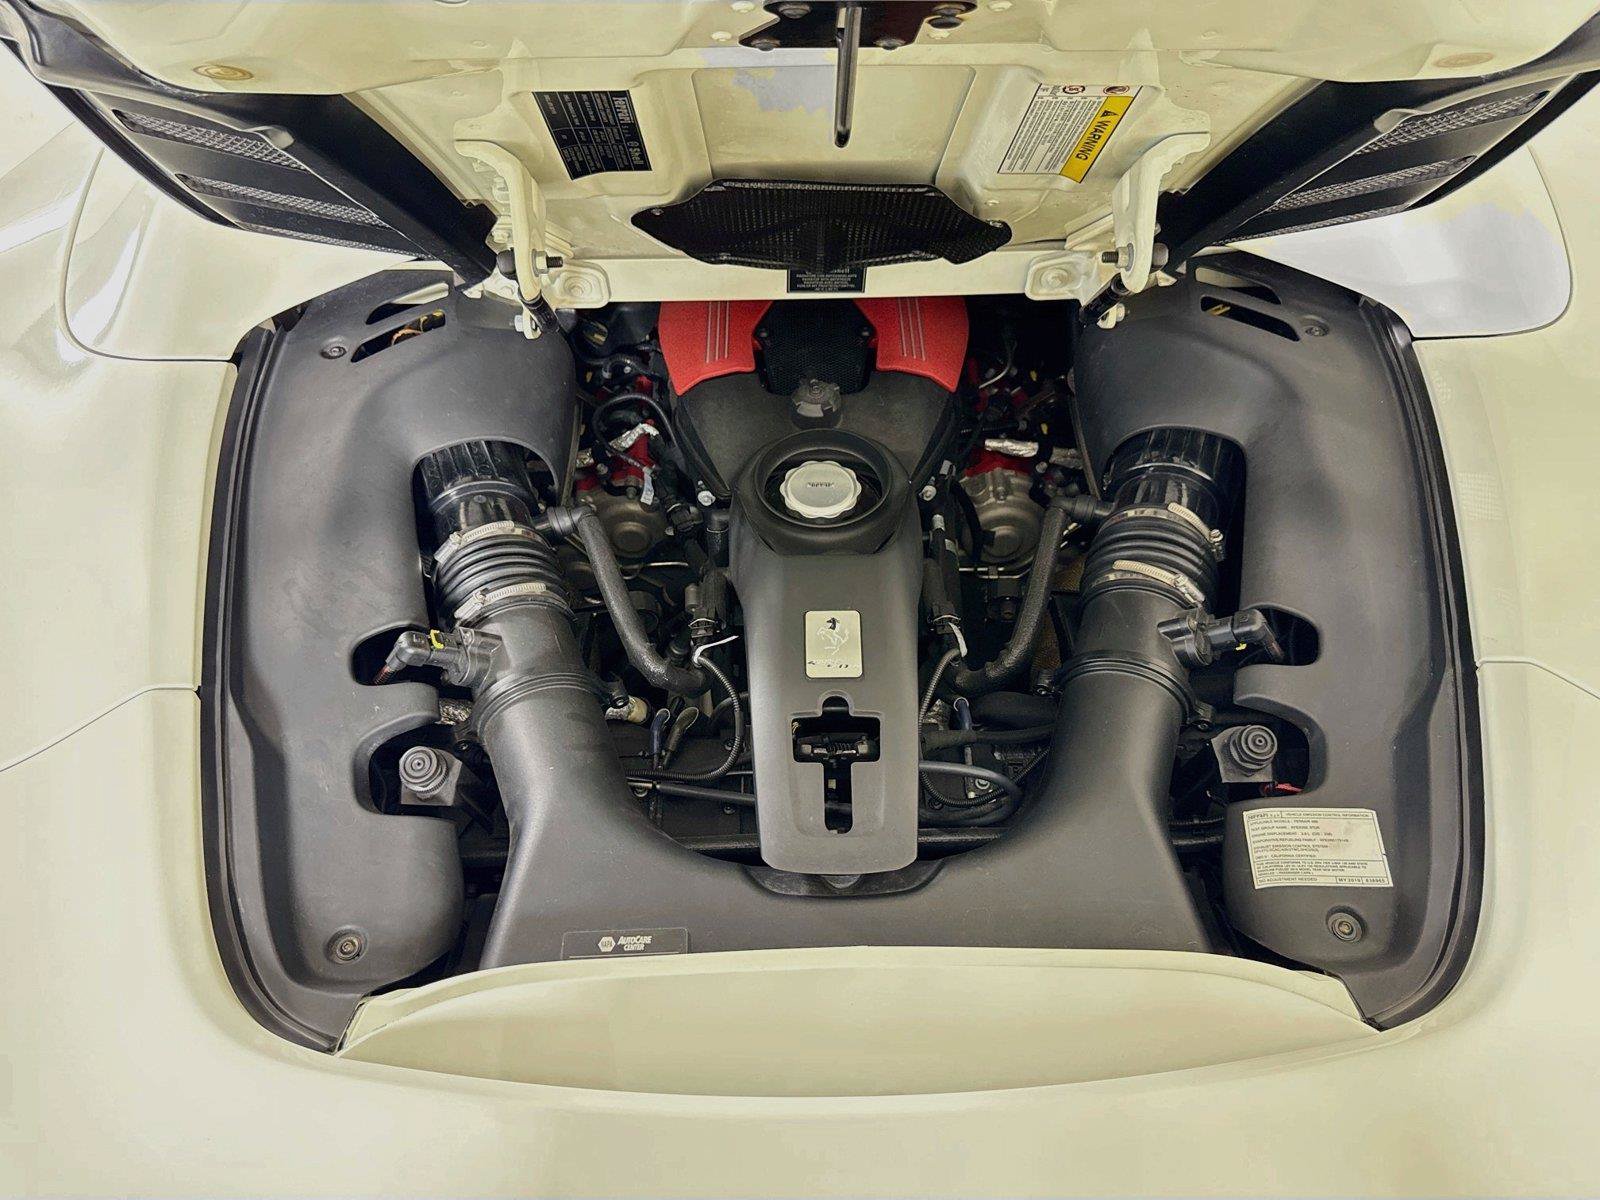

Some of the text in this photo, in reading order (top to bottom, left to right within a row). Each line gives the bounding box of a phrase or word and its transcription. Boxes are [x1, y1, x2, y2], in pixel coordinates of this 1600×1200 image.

[612, 97, 634, 124] Ferrari
[1076, 120, 1111, 160] WARNING
[629, 148, 644, 164] Shell
